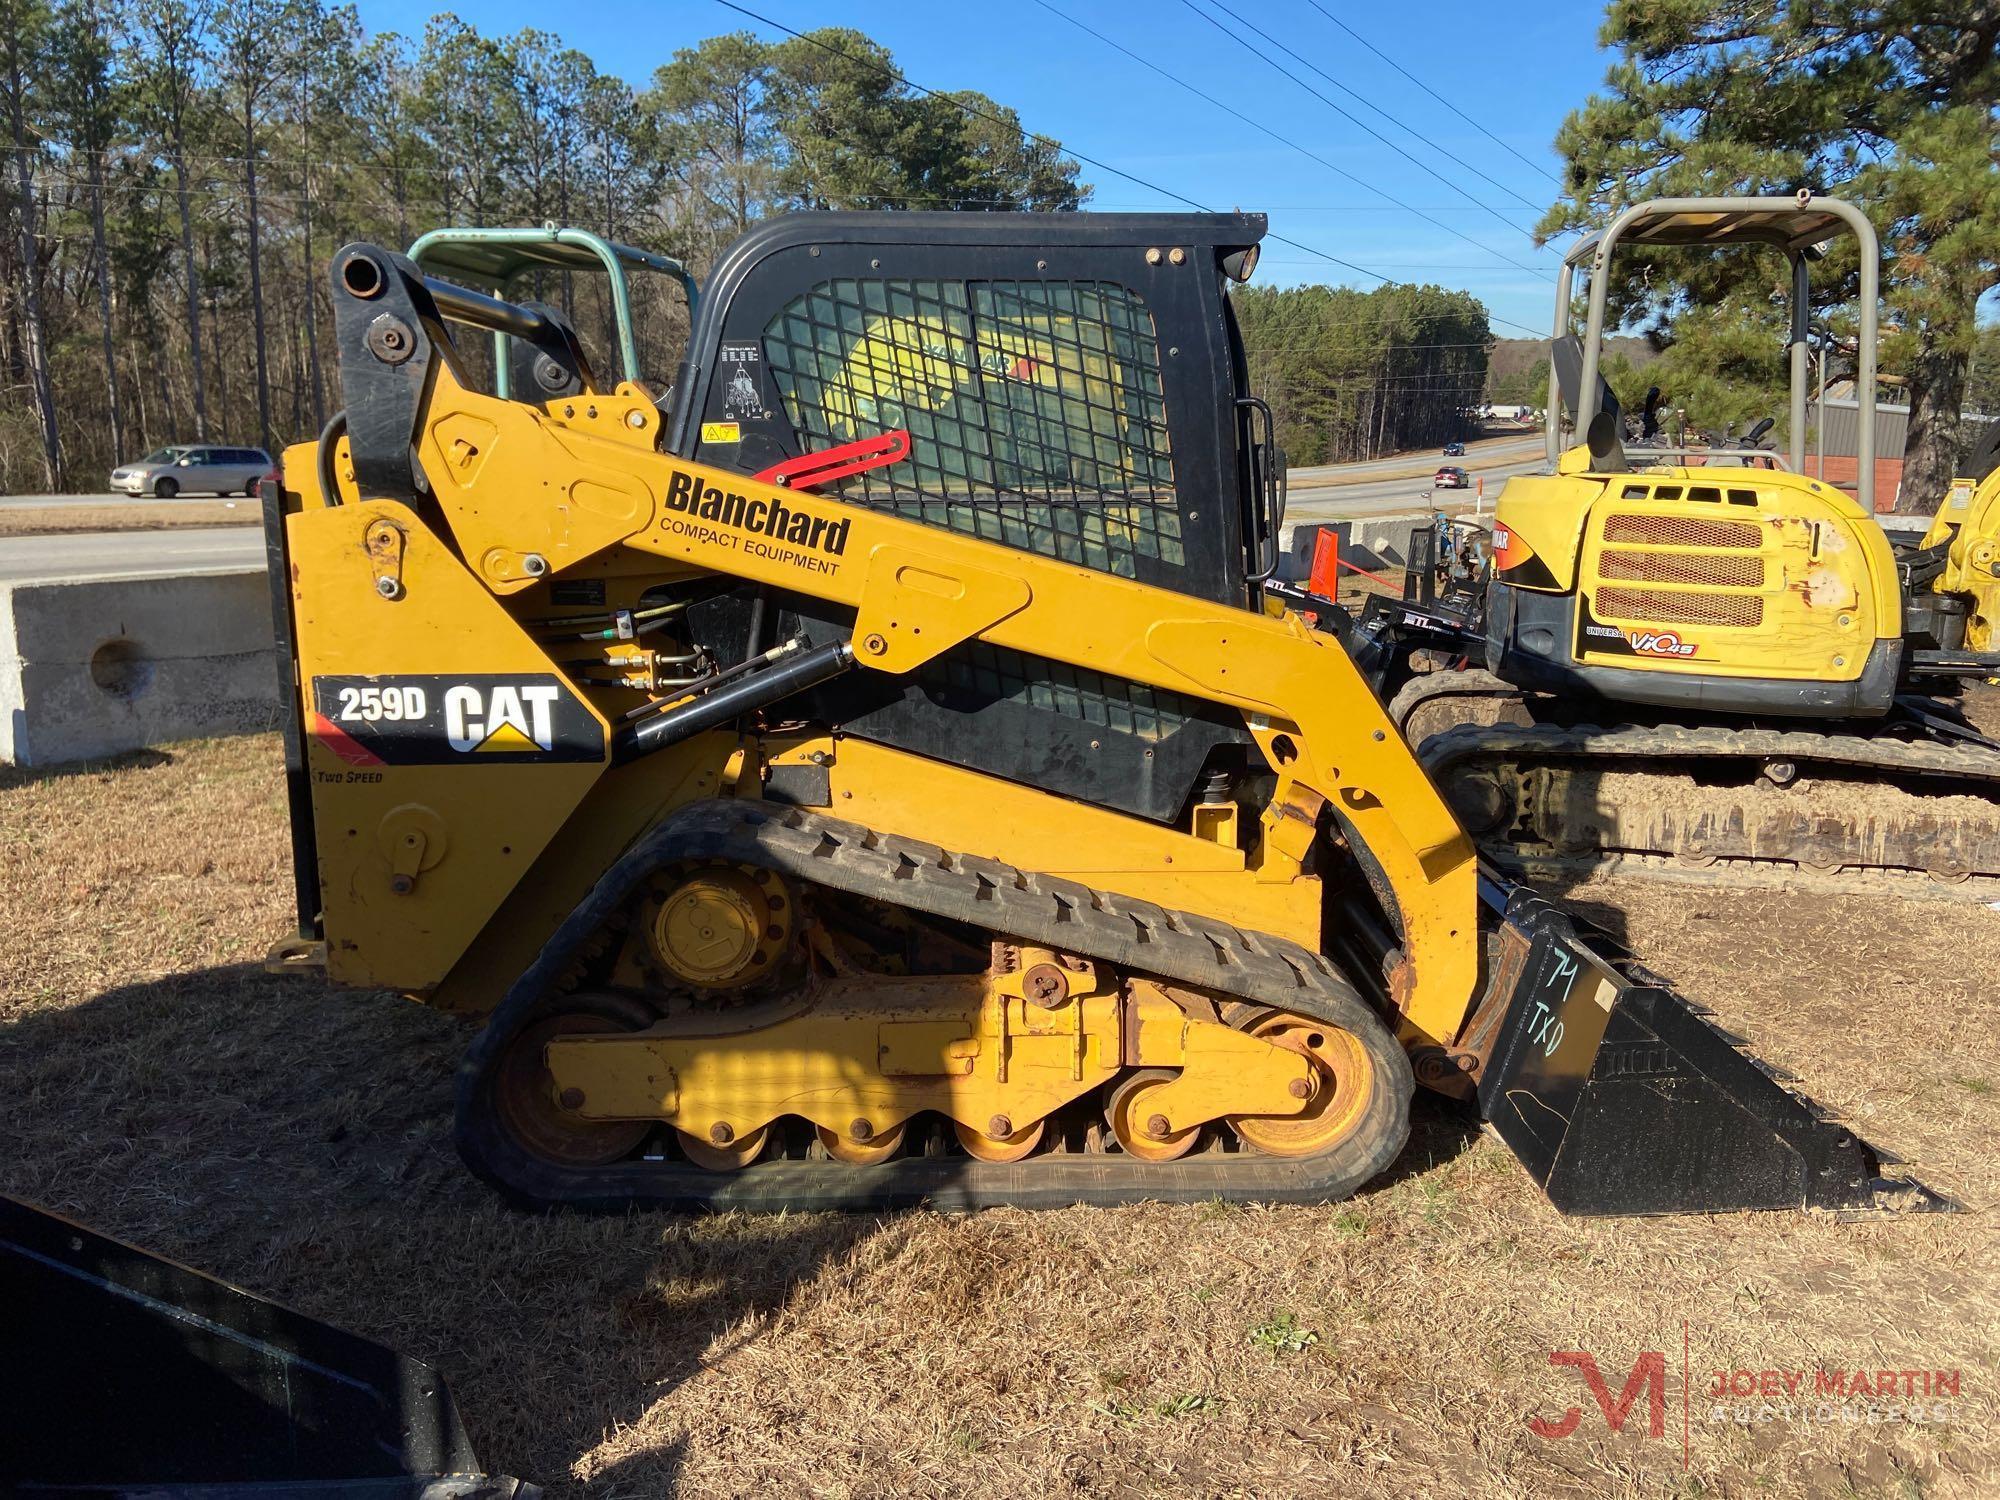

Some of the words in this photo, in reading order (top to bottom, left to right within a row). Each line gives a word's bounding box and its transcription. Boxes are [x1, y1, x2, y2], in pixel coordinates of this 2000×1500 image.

[664, 470, 851, 556] Blanchard
[660, 517, 739, 549] COMPACT
[744, 539, 840, 576] EQUIPMENT
[1586, 626, 1626, 639] UNIVERSAL
[338, 686, 426, 721] 259D
[445, 685, 558, 752] CAT
